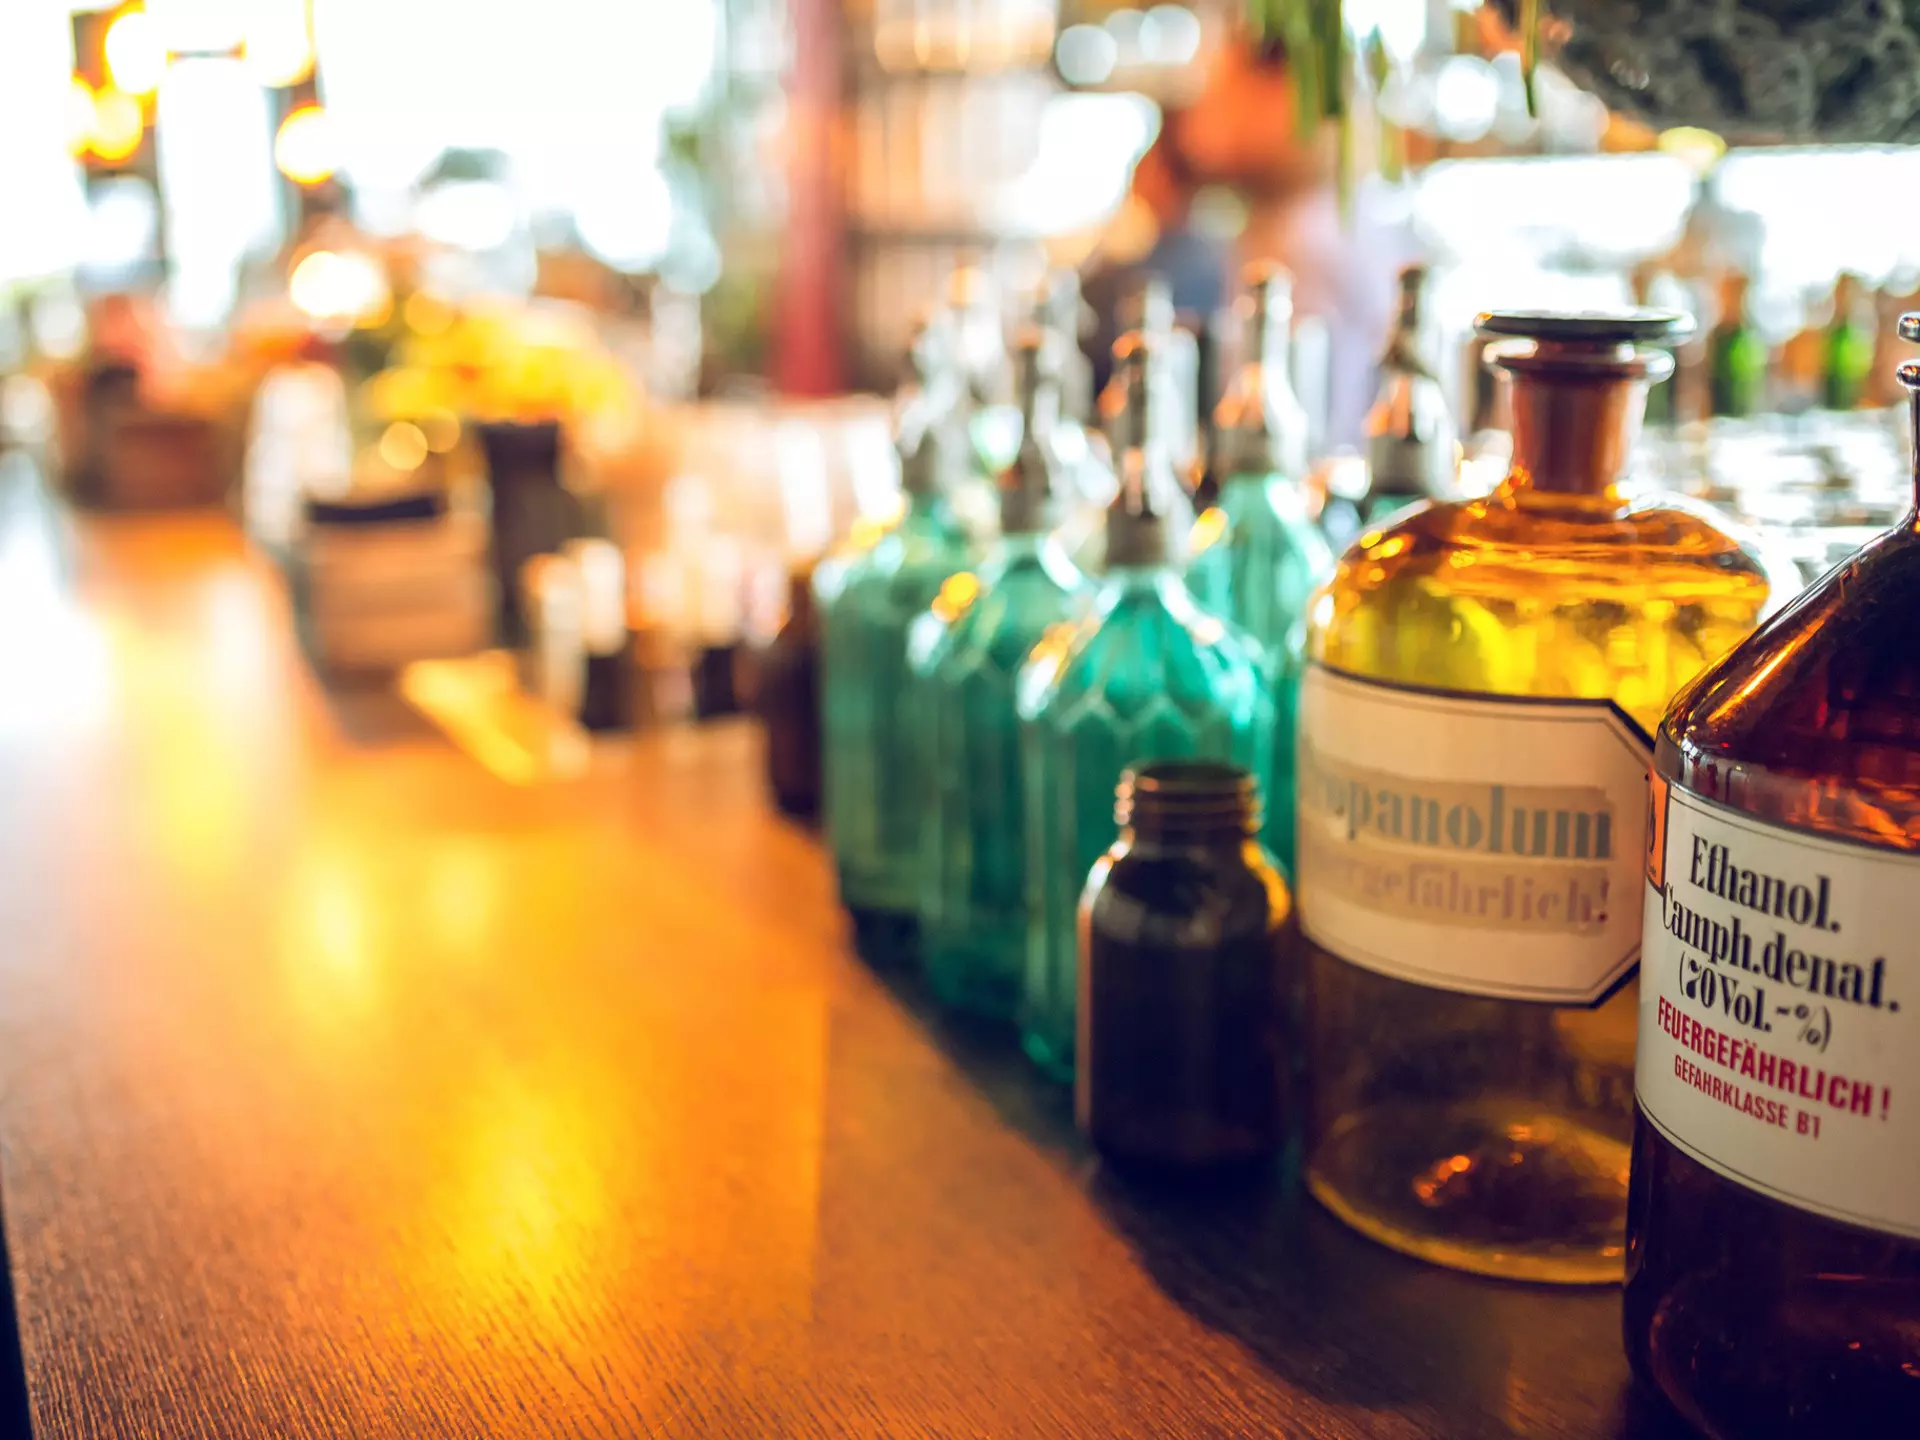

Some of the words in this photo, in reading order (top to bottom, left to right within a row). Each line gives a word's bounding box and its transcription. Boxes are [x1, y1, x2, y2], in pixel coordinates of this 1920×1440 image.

[1688, 833, 1842, 933] Ethanol.
[1674, 1054, 1789, 1130] GEFAHRKLASSE
[1796, 1109, 1822, 1141] B1
